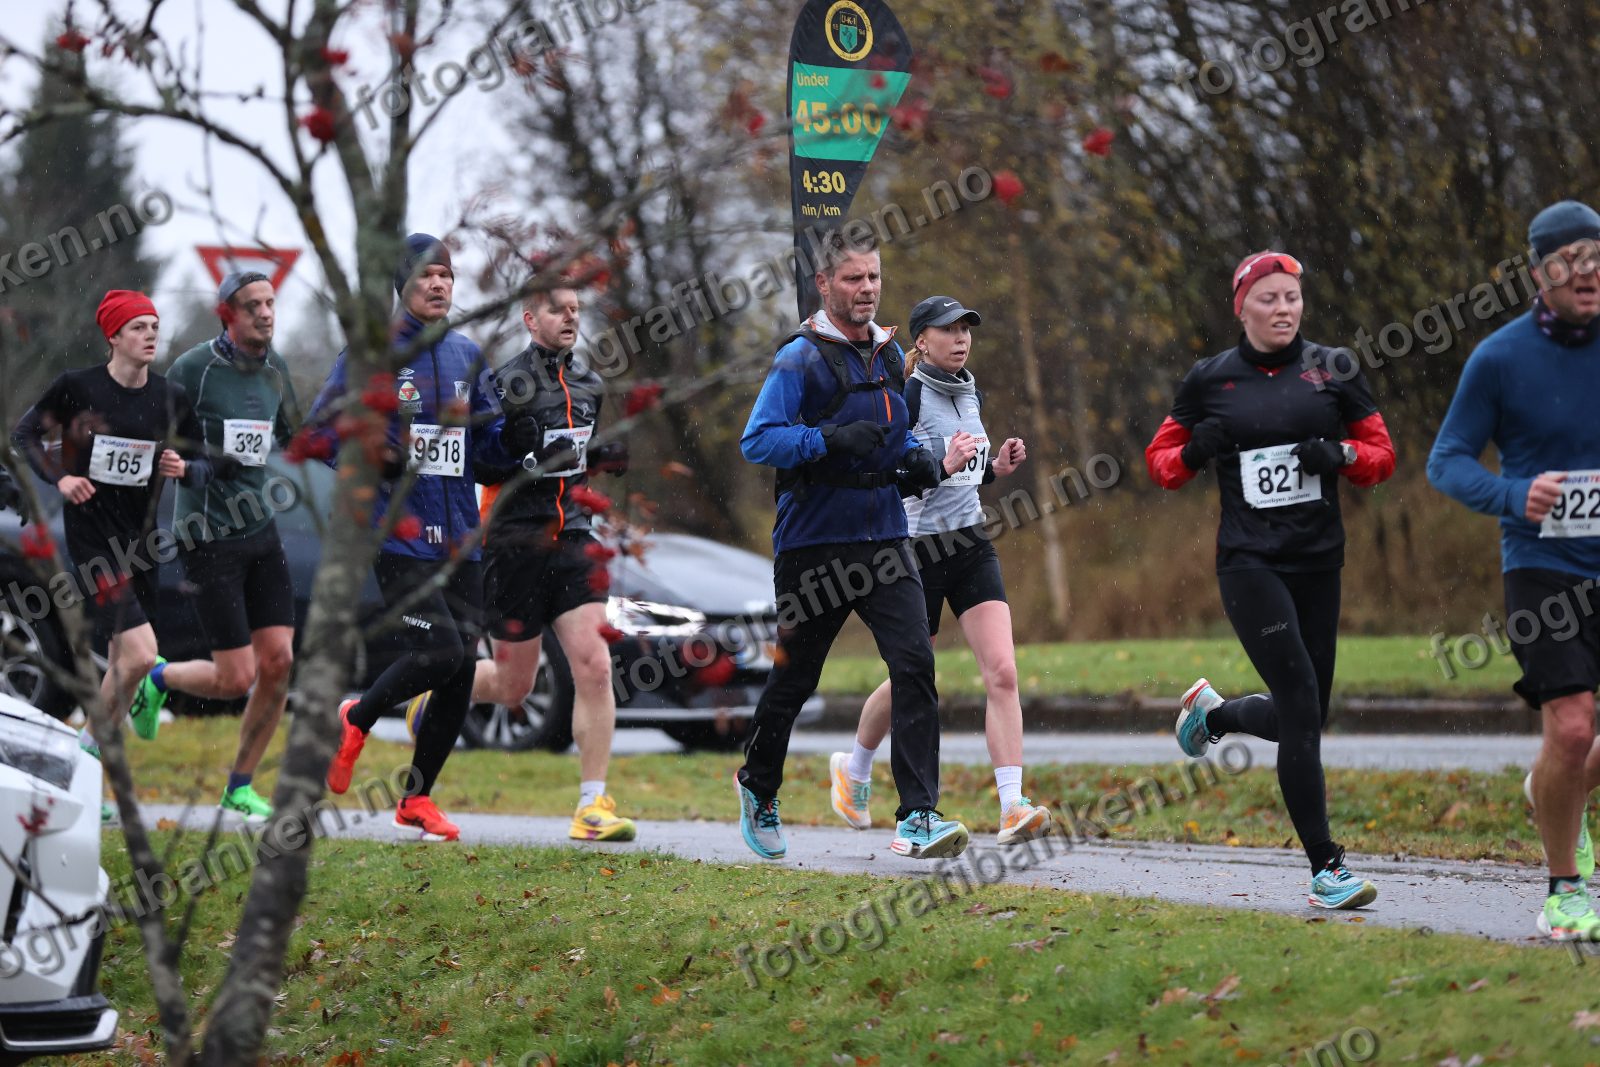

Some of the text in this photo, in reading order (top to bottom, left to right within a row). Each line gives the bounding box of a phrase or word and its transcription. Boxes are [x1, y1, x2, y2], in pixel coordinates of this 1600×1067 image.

[796, 71, 829, 87] Under
[796, 100, 882, 135] 45:00
[802, 170, 846, 194] 4:30
[106, 449, 143, 475] 165
[414, 436, 460, 464] 9518
[1258, 463, 1303, 495] 821
[1551, 487, 1600, 521] 922
[425, 526, 442, 543] TN
[402, 615, 432, 630] TRIMTEX
